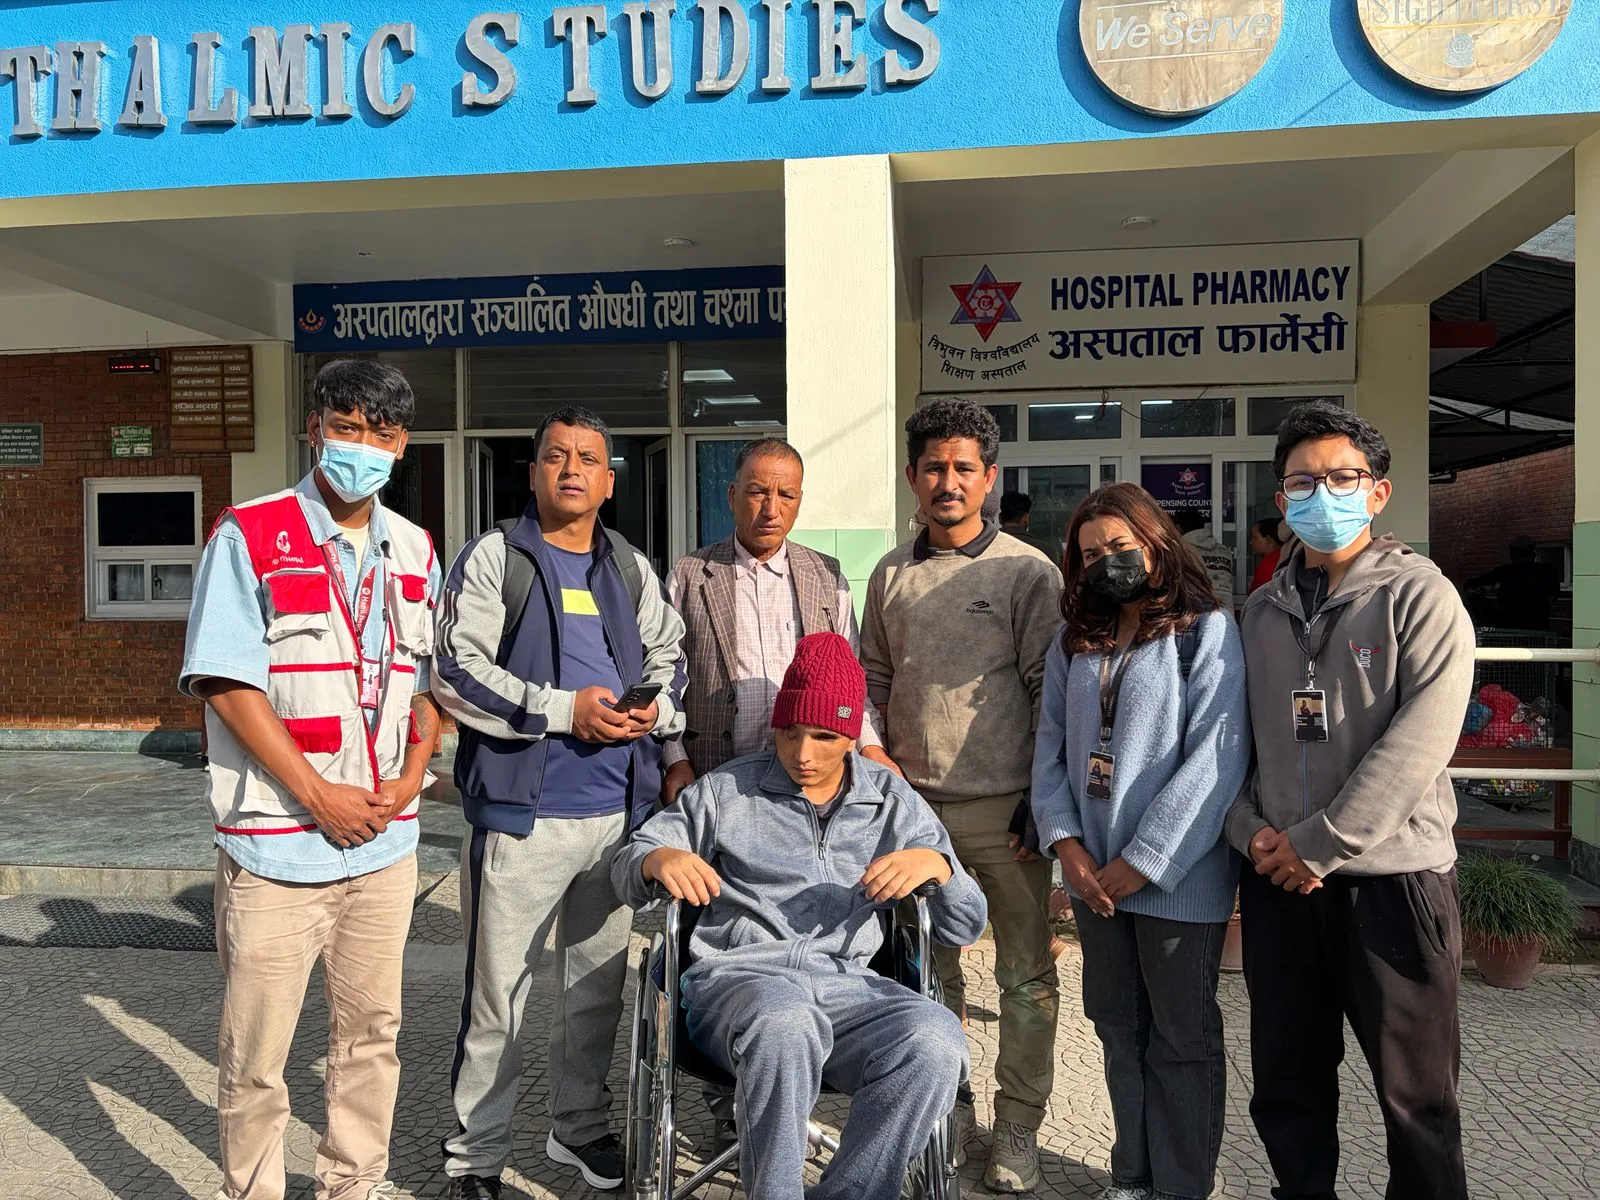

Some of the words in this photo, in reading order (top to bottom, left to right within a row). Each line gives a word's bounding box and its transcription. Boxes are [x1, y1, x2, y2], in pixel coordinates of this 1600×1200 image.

[1096, 16, 1151, 50] We
[1159, 12, 1272, 46] Serve
[1051, 274, 1183, 310] HOSPITAL
[1193, 266, 1351, 306] PHARMACY
[333, 299, 464, 344] अस्पतालद्वारा
[471, 283, 571, 336] सञ्चालित
[578, 280, 647, 331] औषधी
[653, 291, 696, 329] तथा
[704, 287, 761, 328] चश्मा
[927, 334, 966, 359] त्रिभुवन
[1049, 326, 1204, 360] अस्पताल
[1216, 312, 1349, 354] फार्मेसी
[941, 360, 975, 380] शिक्षण
[981, 360, 1027, 380] अस्पताल
